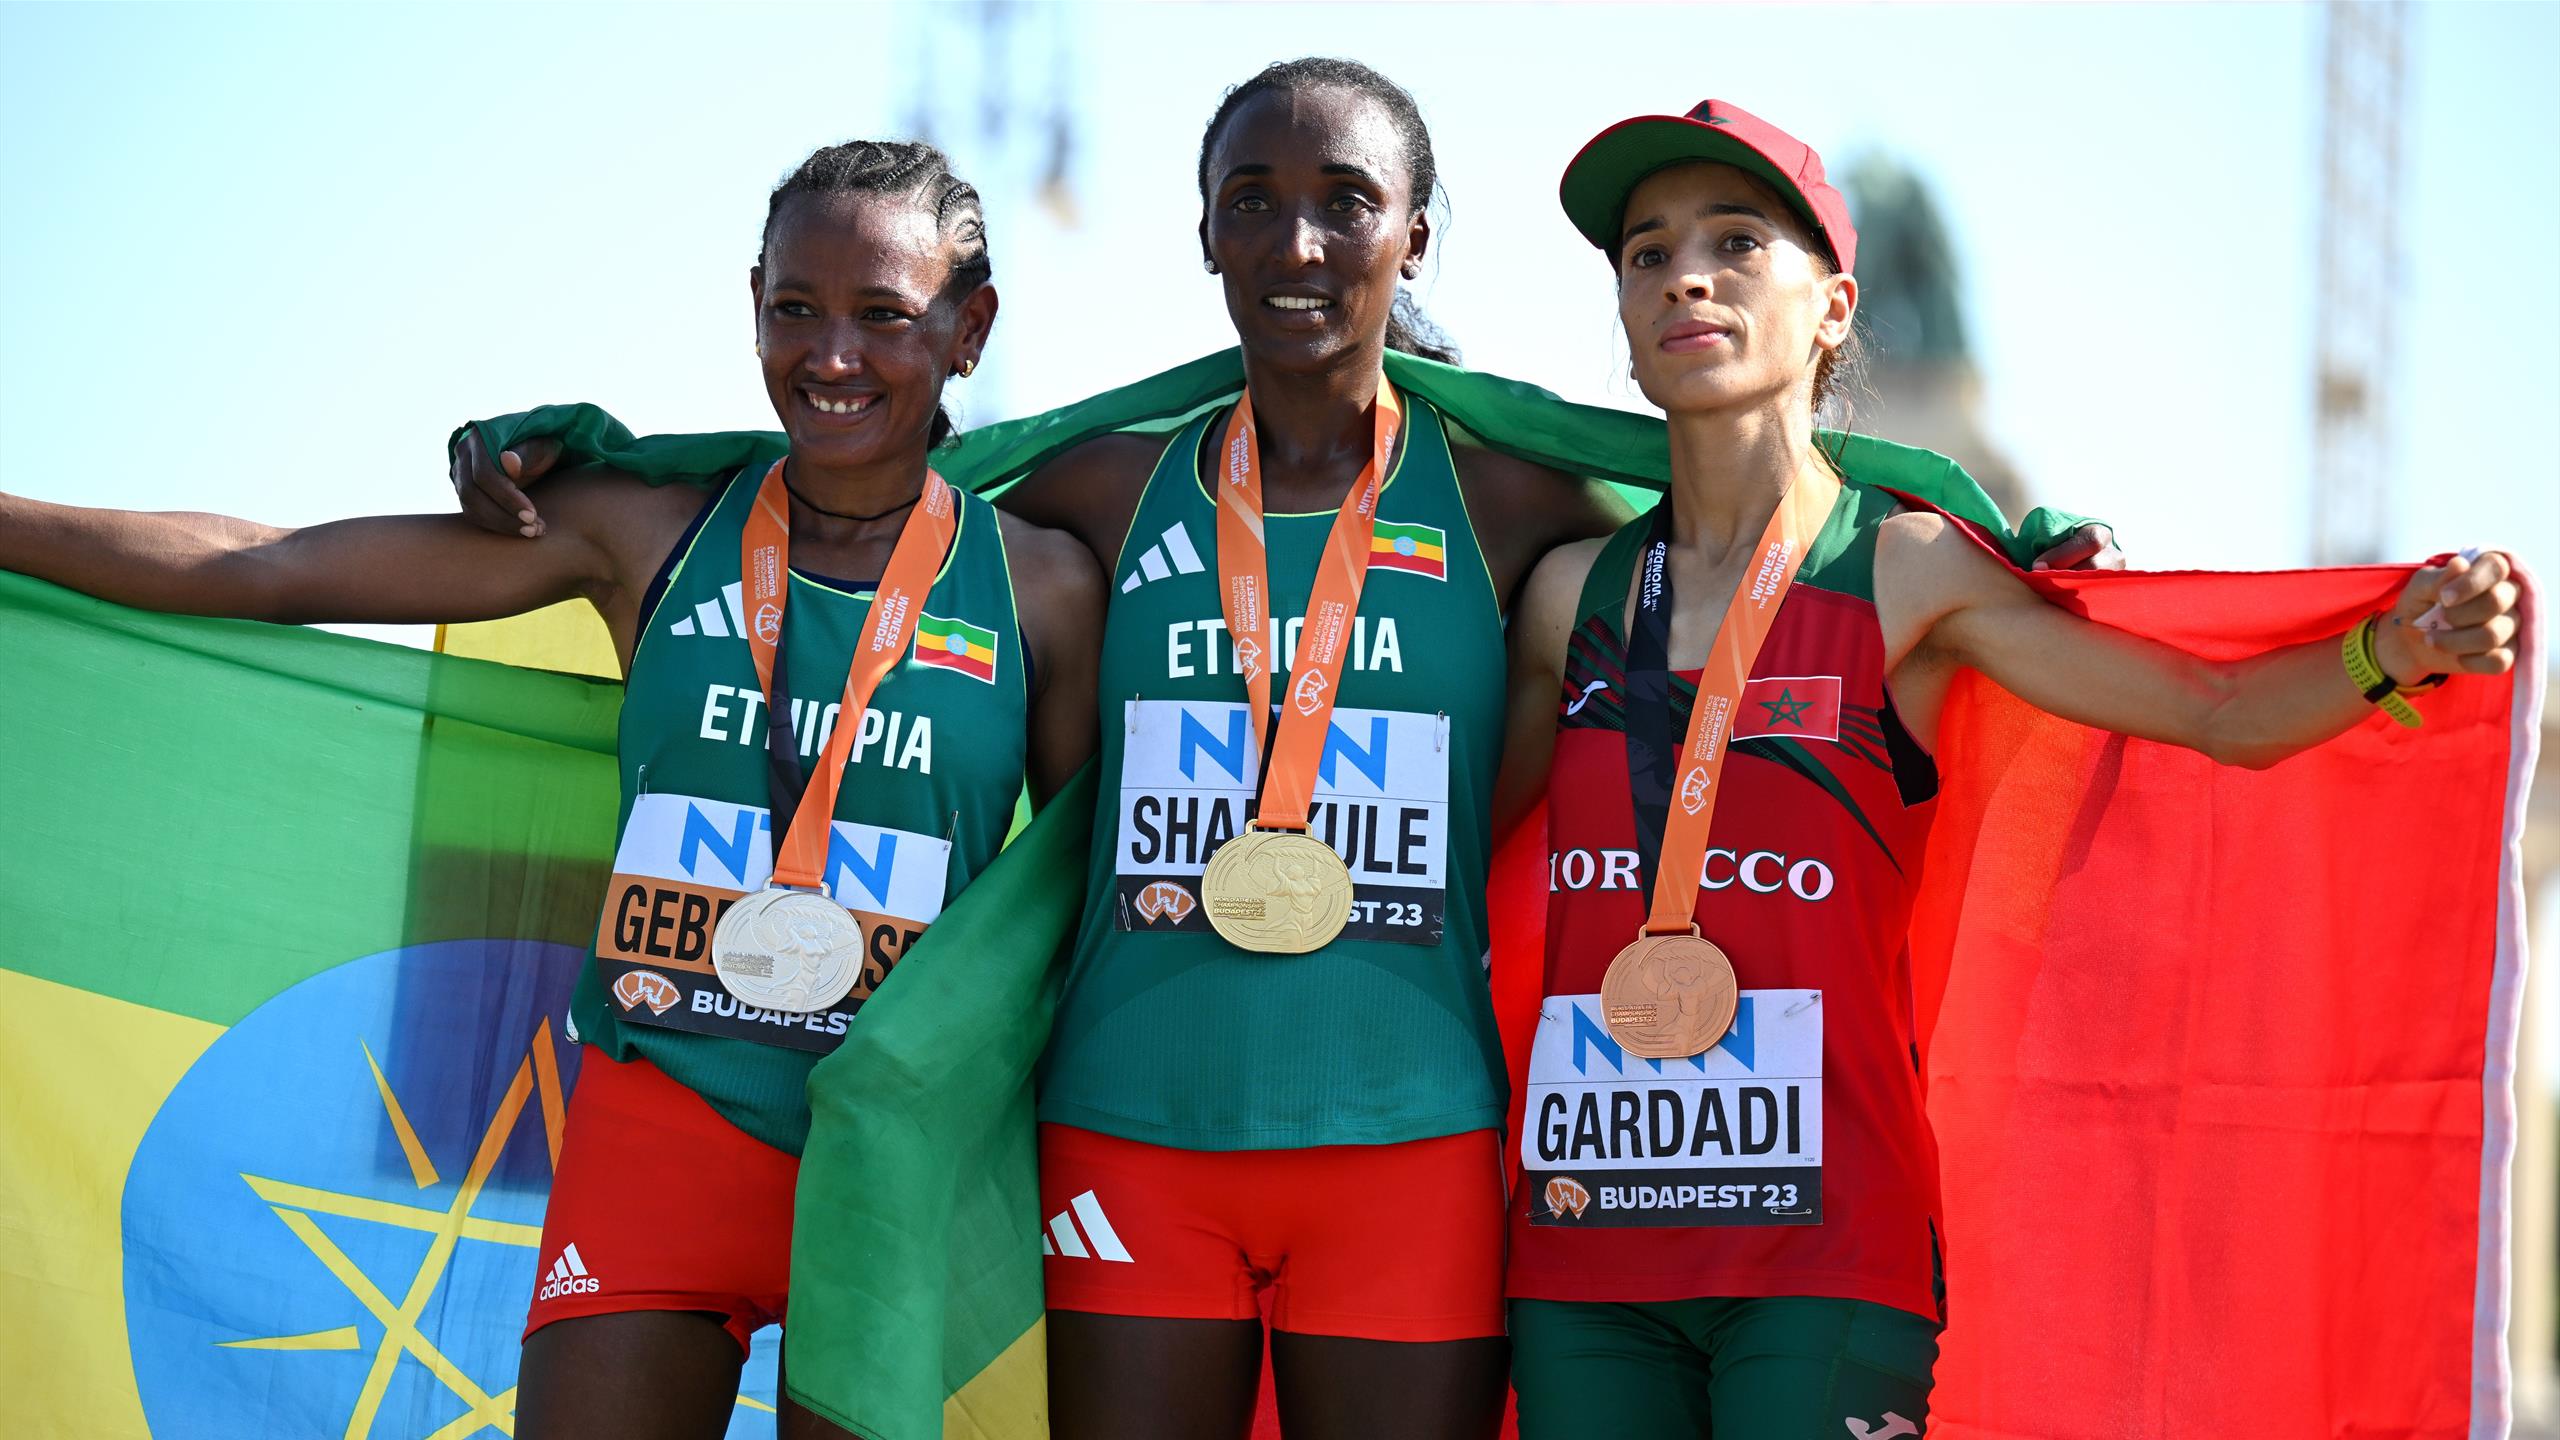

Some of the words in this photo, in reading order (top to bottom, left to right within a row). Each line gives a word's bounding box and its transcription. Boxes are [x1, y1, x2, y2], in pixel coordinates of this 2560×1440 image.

[1356, 479, 1375, 513] WITN
[767, 555, 776, 597] BUDAPEST
[1232, 575, 1240, 608] ATHLETICS
[1246, 575, 1254, 585] 23
[1643, 549, 1654, 608] WITNESS
[1652, 541, 1667, 597] WONDER
[1750, 542, 1781, 600] WITNESS
[1758, 595, 1769, 609] THE
[1764, 539, 1794, 595] WONDER
[871, 598, 896, 652] WONDER
[885, 595, 910, 648] WITNESS
[1239, 575, 1248, 632] CHAMPIONSHIPS
[1247, 587, 1257, 632] BUDAPEST
[1308, 637, 1318, 662] WORLD
[1315, 601, 1329, 636] ATHLETICS
[1169, 616, 1403, 679] ETIIA
[1315, 602, 1336, 663] CHAMPIONSHIPS
[1322, 615, 1341, 664] BUDAPEST
[1336, 603, 1344, 614] 23
[1179, 707, 1388, 793] NN
[1694, 733, 1704, 759] WORLD
[1700, 695, 1714, 733] ATHLETICS
[1700, 696, 1720, 760] CHAMPIONSHIPS
[1706, 709, 1723, 760] BUDAPEST
[1719, 697, 1728, 709] 23
[678, 801, 898, 910] NN
[1549, 849, 1834, 901] ORCCO
[1386, 903, 1423, 926] 23
[691, 989, 856, 1035] BUDAPES
[1572, 997, 1755, 1077] NN
[1537, 1086, 1800, 1162] GARDADI
[1600, 1185, 1757, 1209] BUDAPEST
[1763, 1184, 1798, 1207] 23
[540, 1276, 600, 1301] adidas
